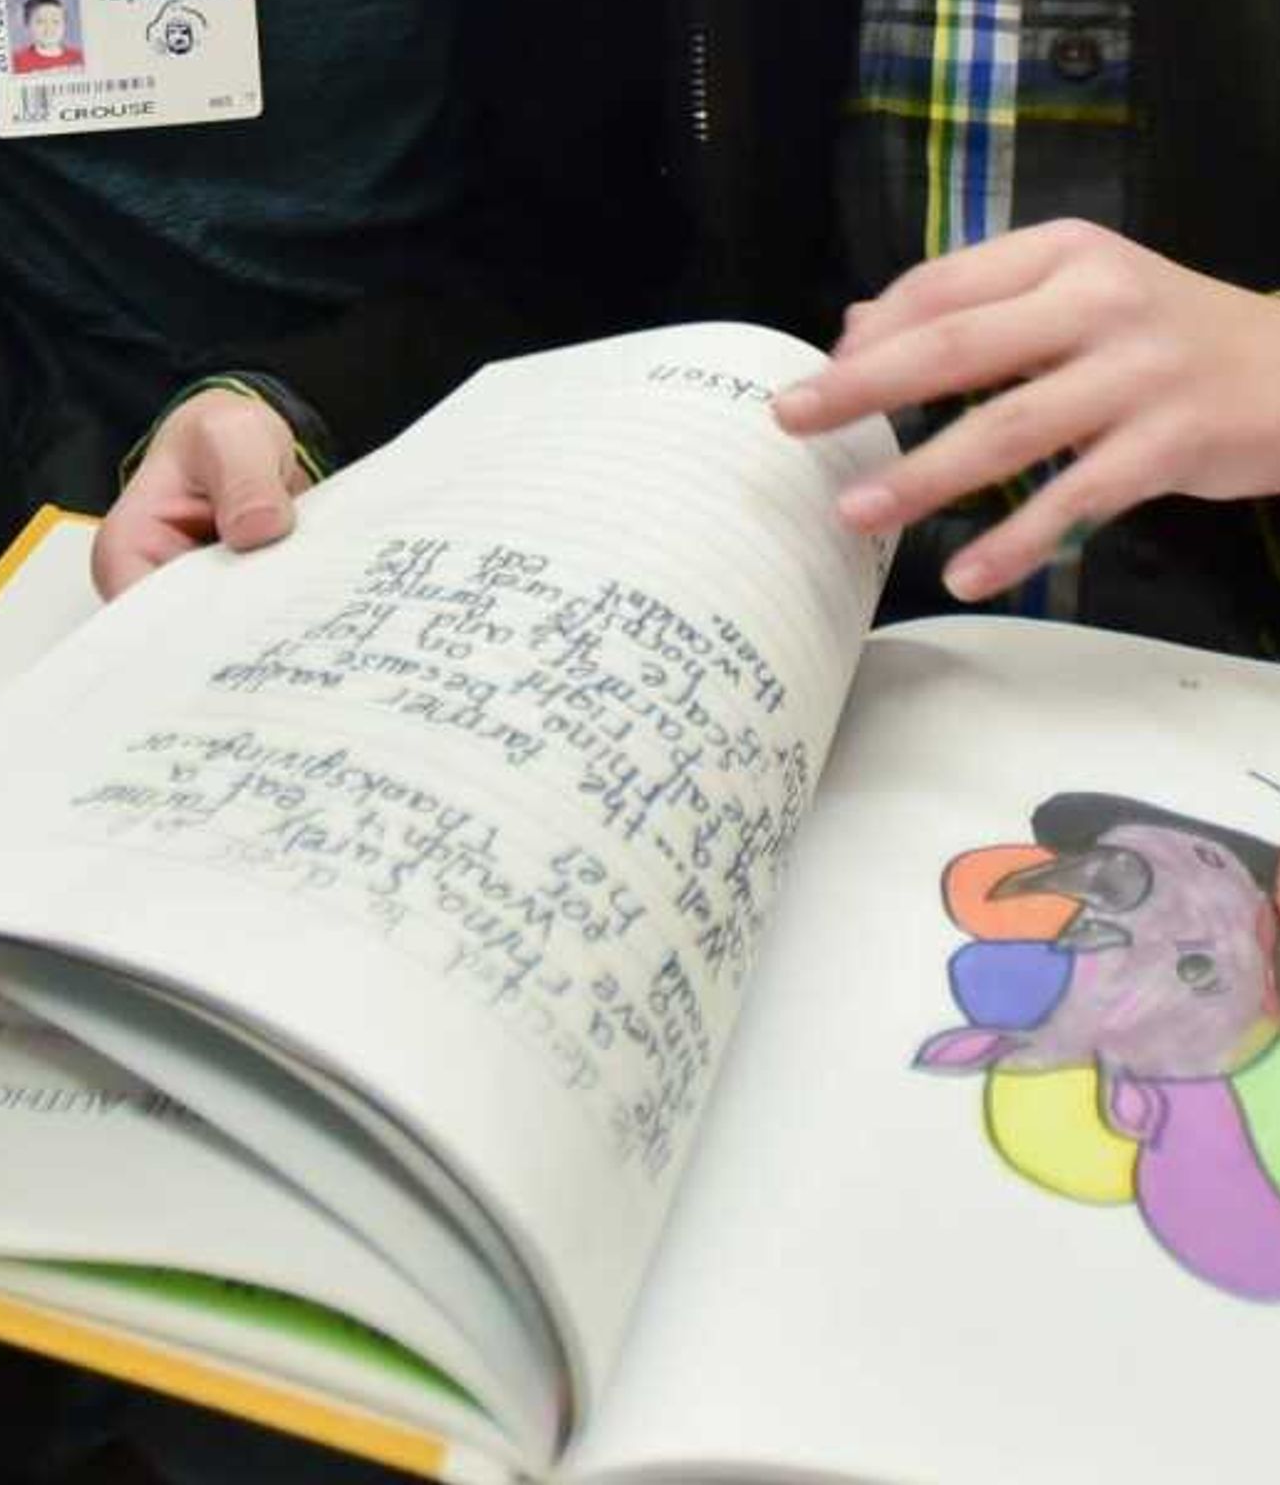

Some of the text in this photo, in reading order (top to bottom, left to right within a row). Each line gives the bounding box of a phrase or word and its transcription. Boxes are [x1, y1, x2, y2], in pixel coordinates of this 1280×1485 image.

[59, 100, 158, 122] CROUSE
[646, 364, 774, 400] ckson
[479, 544, 549, 575] eat
[346, 596, 397, 623] he
[424, 611, 515, 646] and
[417, 633, 473, 661] on
[336, 652, 500, 705] because
[507, 667, 635, 744] right
[632, 661, 740, 771] scare
[171, 760, 199, 782] a
[539, 713, 665, 805] rhino
[232, 771, 306, 809] eat
[257, 808, 419, 895] Surely
[686, 827, 709, 866] a
[551, 846, 648, 936] he?
